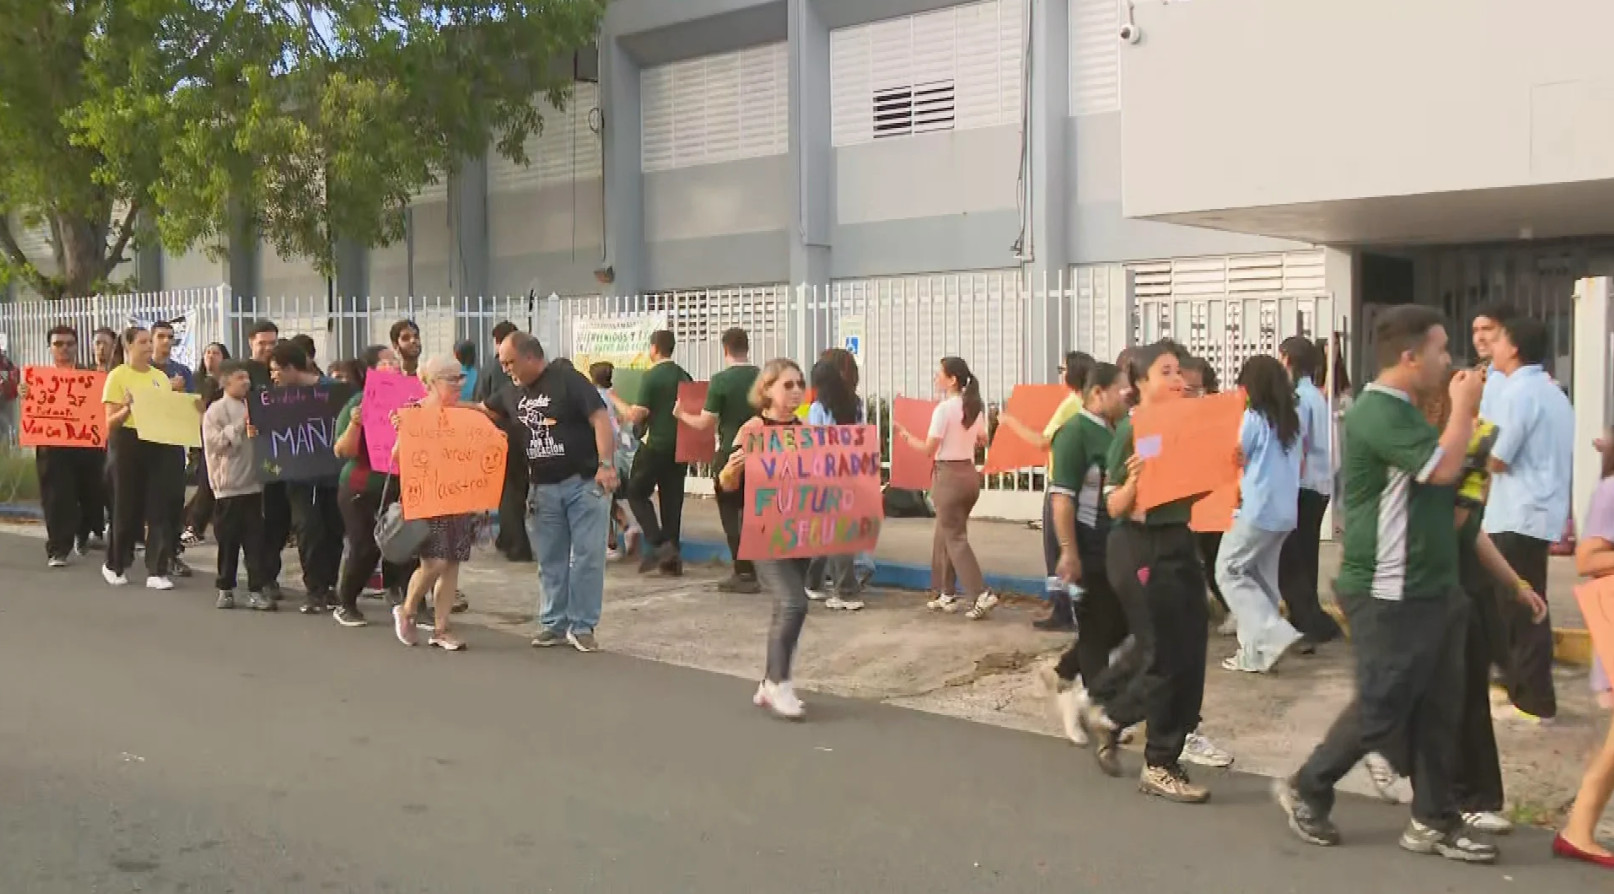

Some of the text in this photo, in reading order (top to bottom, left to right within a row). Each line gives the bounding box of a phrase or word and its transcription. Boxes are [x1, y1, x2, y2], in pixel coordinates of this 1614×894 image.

[746, 426, 866, 453] MAESTROS
[760, 451, 880, 479] VALORADOS
[755, 484, 856, 516] FUTURO
